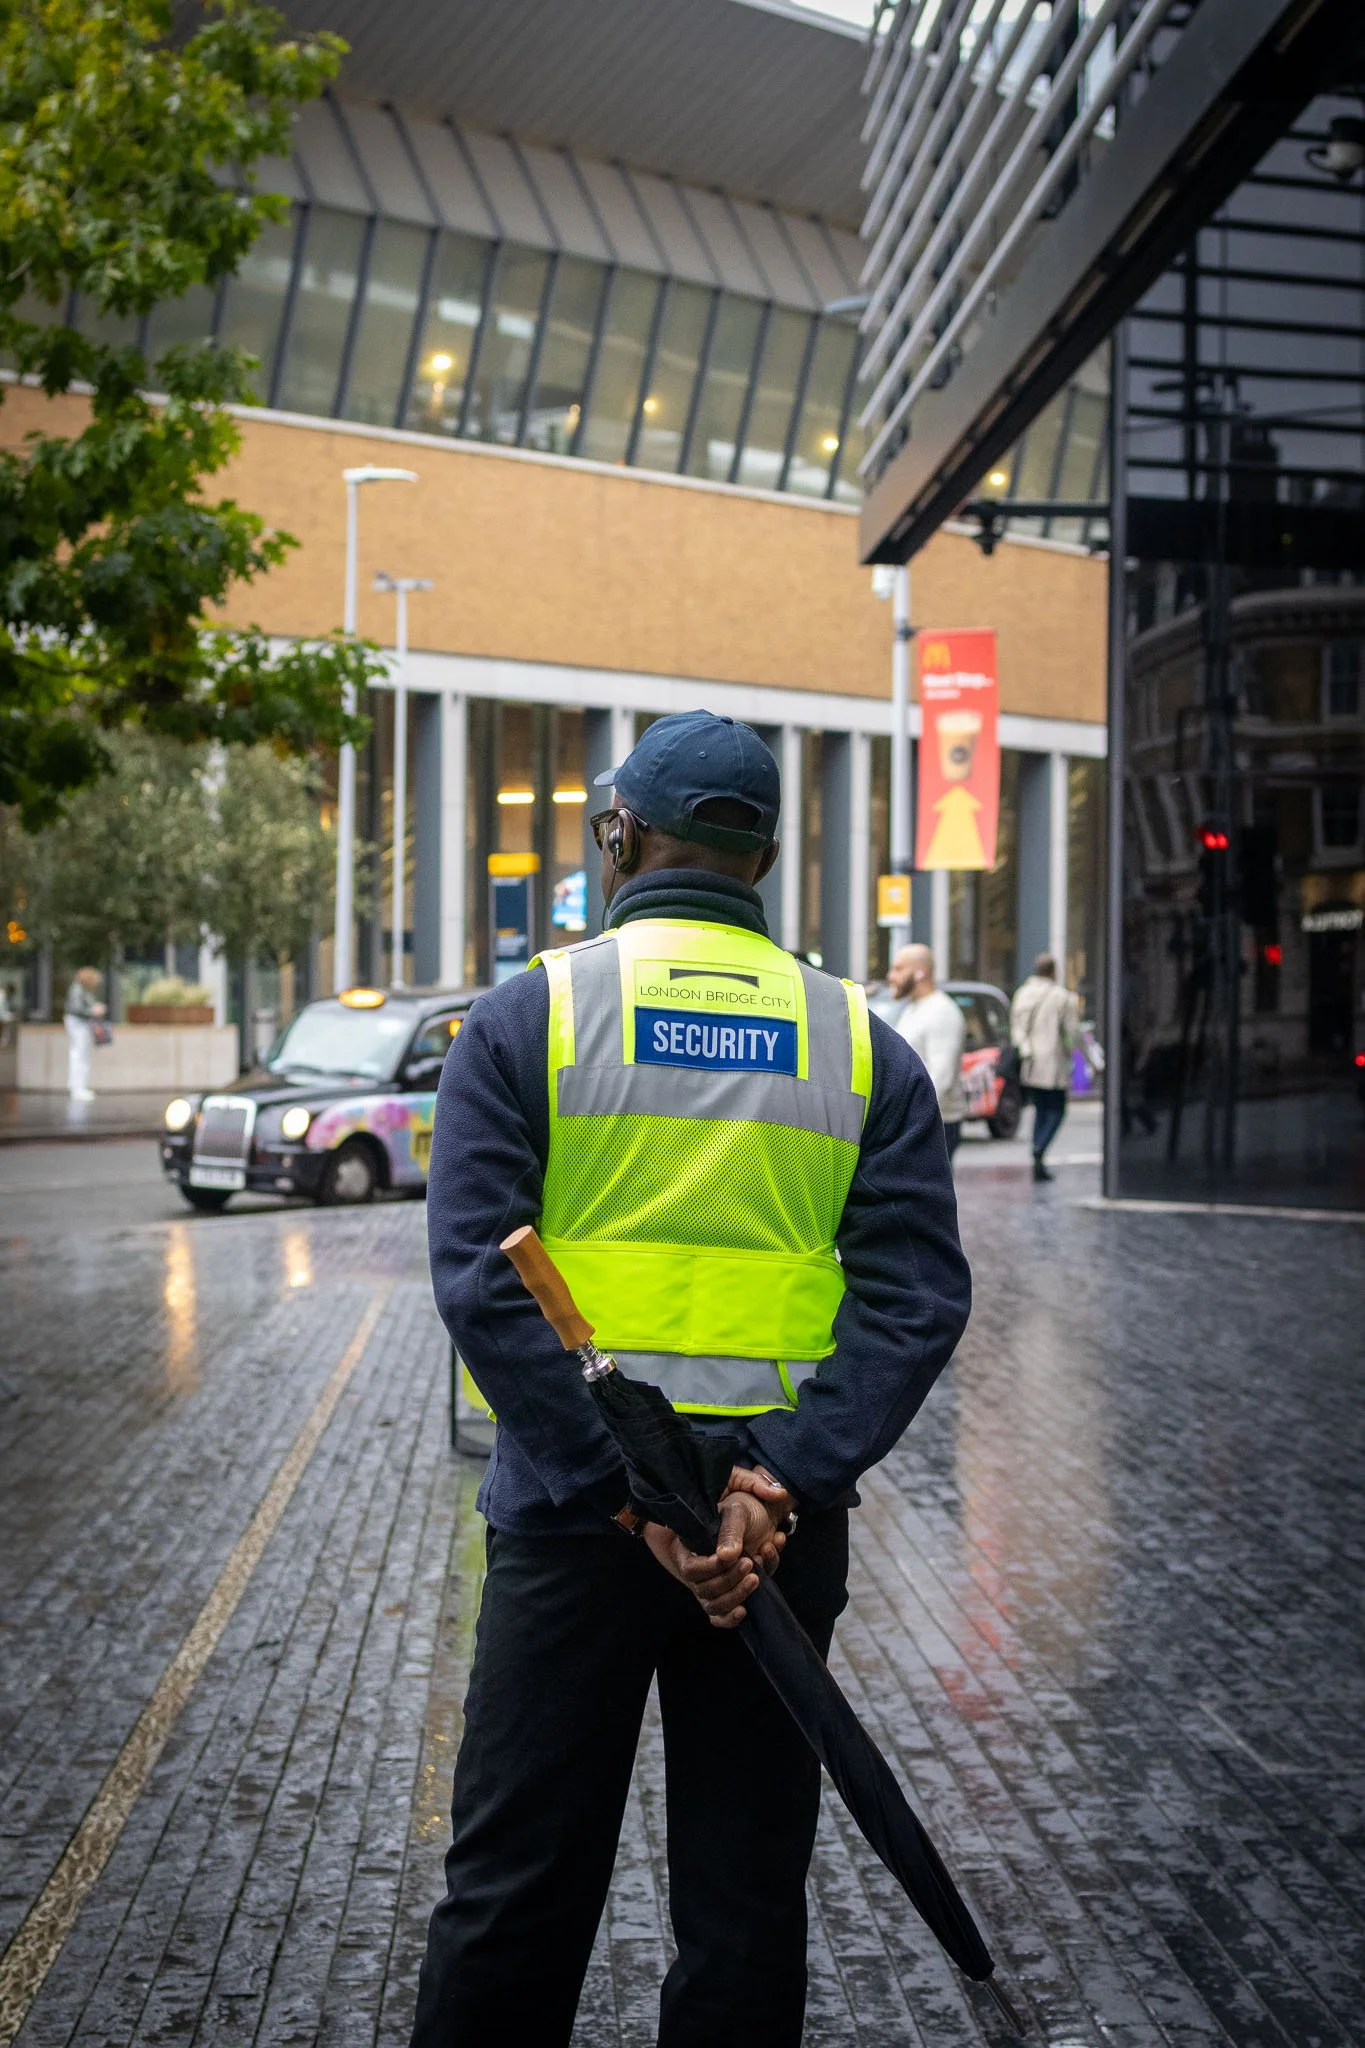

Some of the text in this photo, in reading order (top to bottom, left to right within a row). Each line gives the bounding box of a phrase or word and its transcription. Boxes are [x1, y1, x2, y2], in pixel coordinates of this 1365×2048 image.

[640, 985, 791, 1009] LONDON BRIDGE CITY
[653, 1020, 779, 1061] SECURITY
